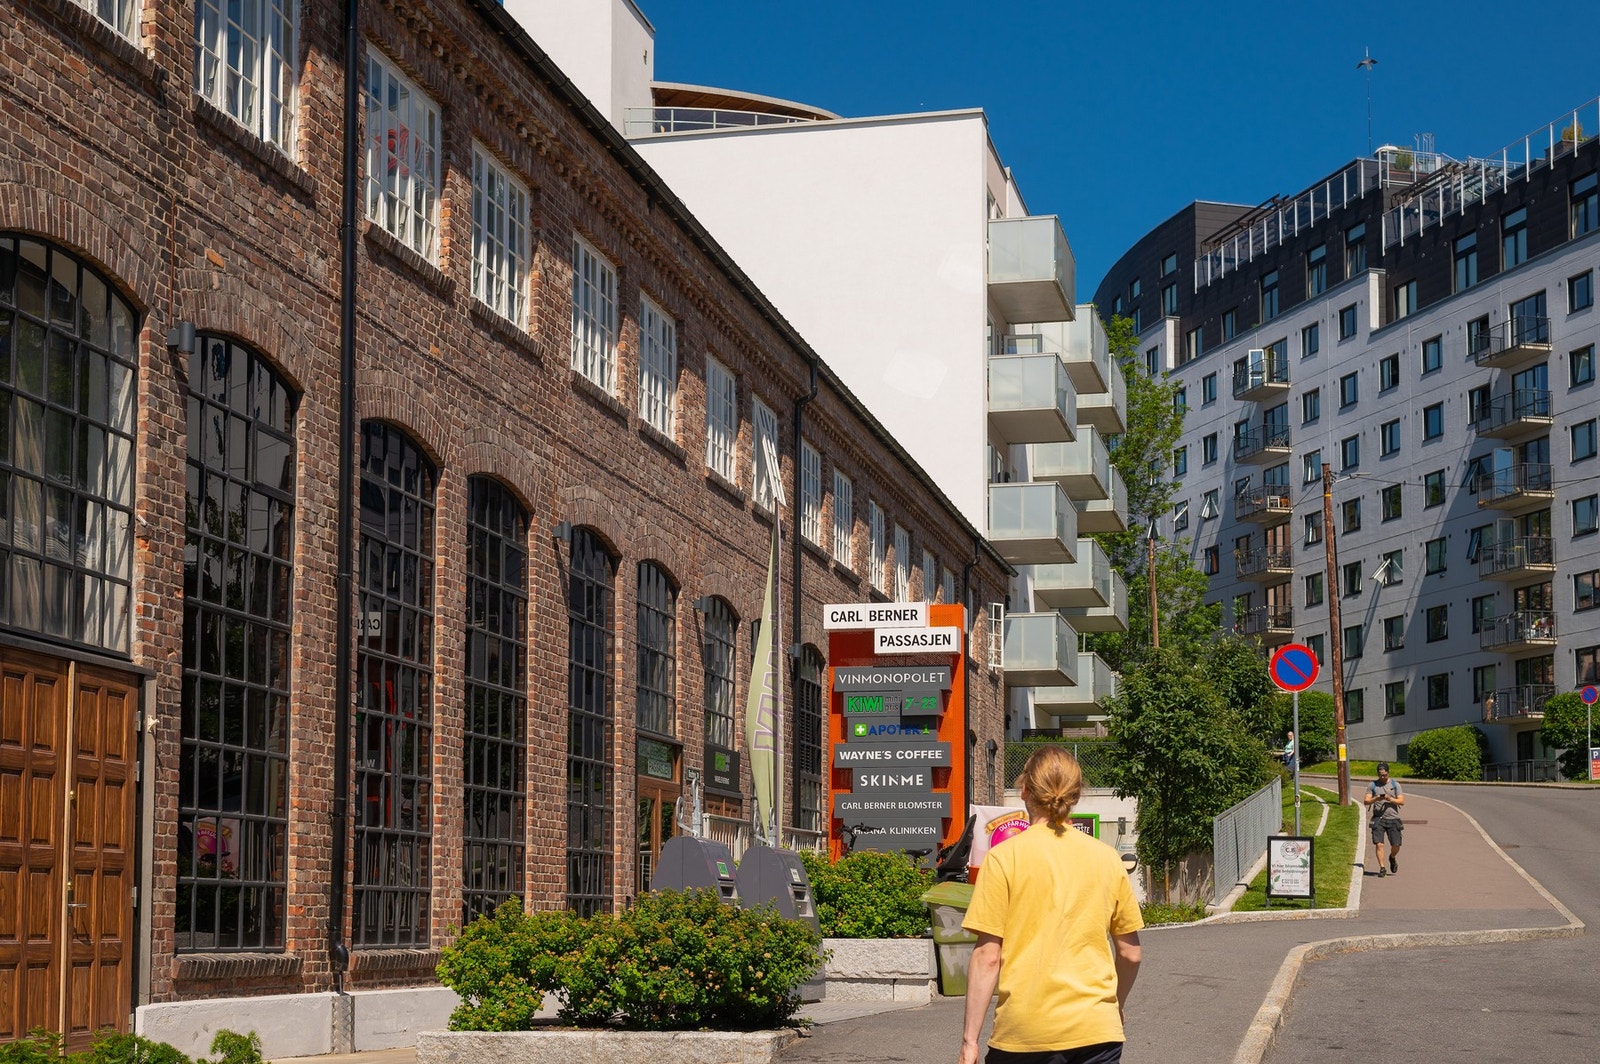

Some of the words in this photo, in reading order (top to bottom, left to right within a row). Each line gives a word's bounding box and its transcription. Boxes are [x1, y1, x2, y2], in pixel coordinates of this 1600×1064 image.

[830, 610, 863, 623] CARL
[869, 609, 918, 622] BERNER
[880, 634, 951, 647] PASSASJEN
[838, 672, 945, 684] VINMONOPOLET
[847, 695, 884, 712] KIWI
[884, 702, 899, 713] pris
[868, 724, 922, 735] APOTEK
[896, 750, 943, 759] COFFEE
[841, 802, 862, 810] CARL
[864, 801, 896, 810] BERNER
[898, 801, 943, 809] BLOMSTER
[889, 826, 936, 835] KLINIKKEN
